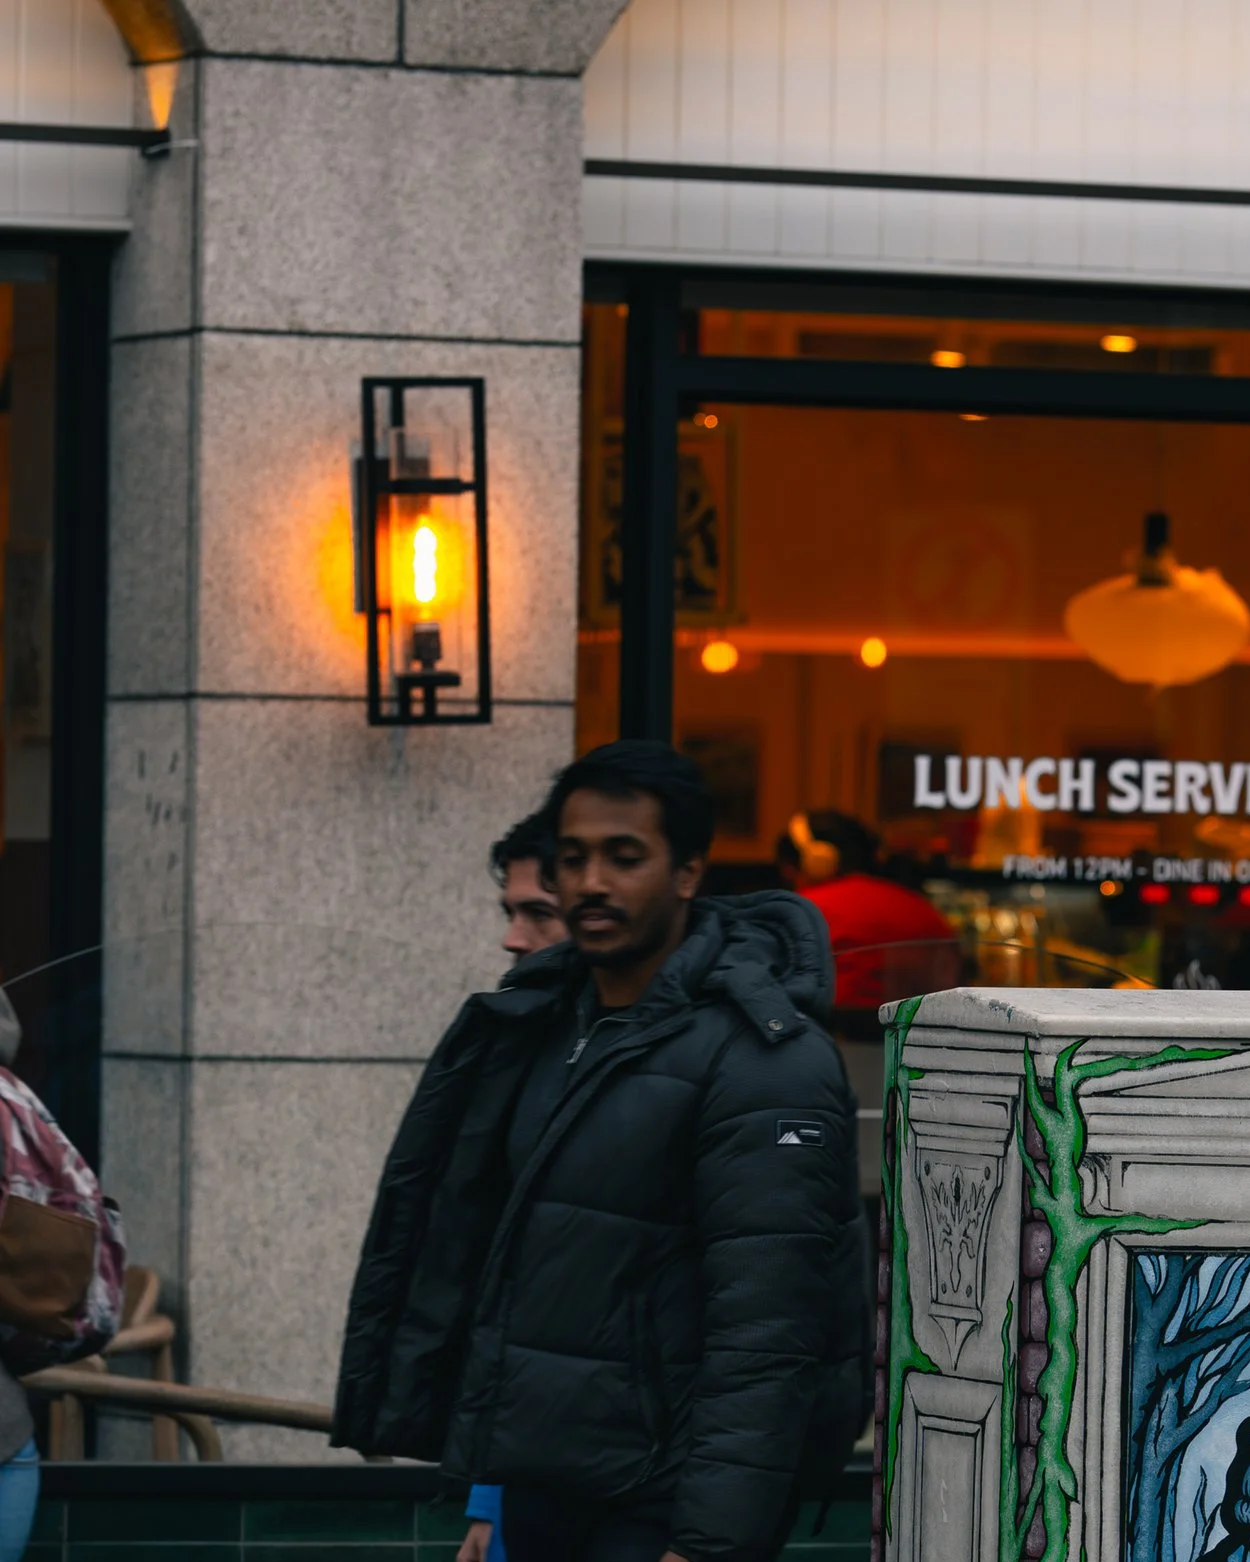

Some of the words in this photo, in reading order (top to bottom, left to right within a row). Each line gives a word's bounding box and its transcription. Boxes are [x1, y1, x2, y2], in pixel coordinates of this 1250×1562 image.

[914, 754, 1096, 811] LUNCH
[1002, 853, 1067, 880] FROM
[1073, 856, 1133, 881] 12PM
[1153, 857, 1201, 883] DINE
[1207, 859, 1232, 883] IN
